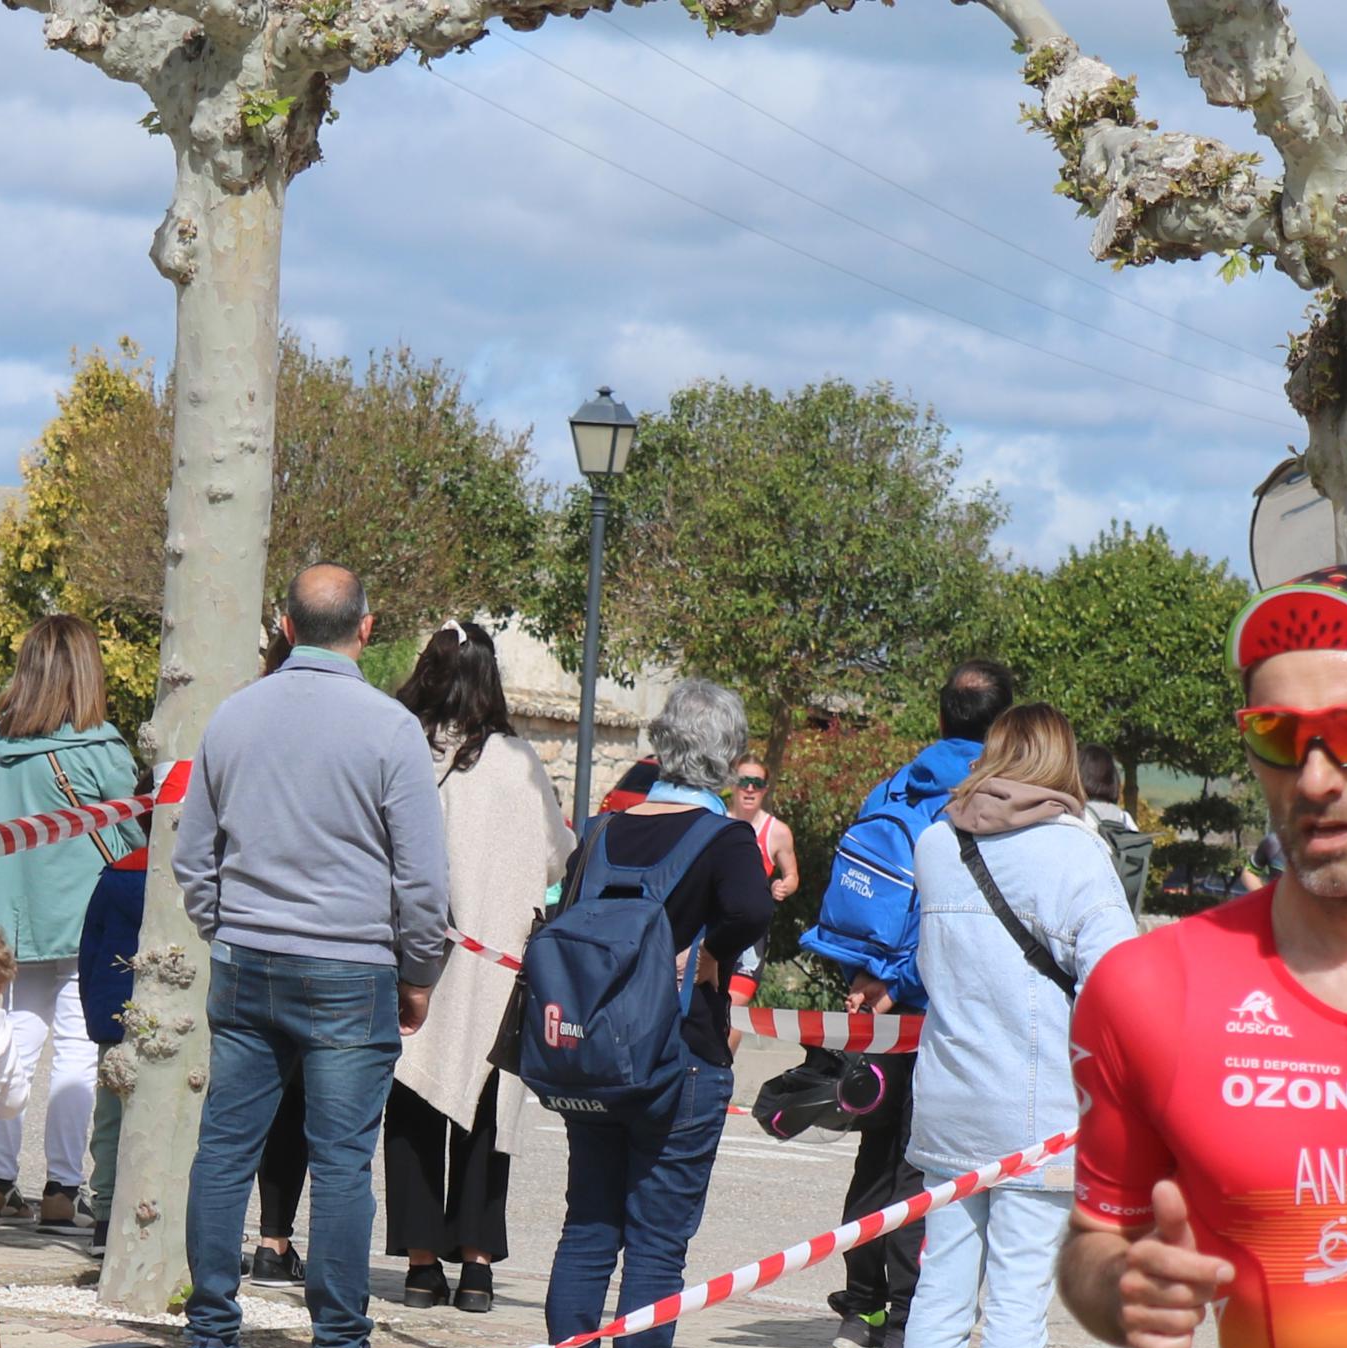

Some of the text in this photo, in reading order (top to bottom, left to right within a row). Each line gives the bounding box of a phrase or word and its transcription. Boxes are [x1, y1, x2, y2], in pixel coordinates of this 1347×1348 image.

[1224, 1056, 1341, 1076] CLUB DEPORTIVO
[546, 1095, 608, 1113] Joma
